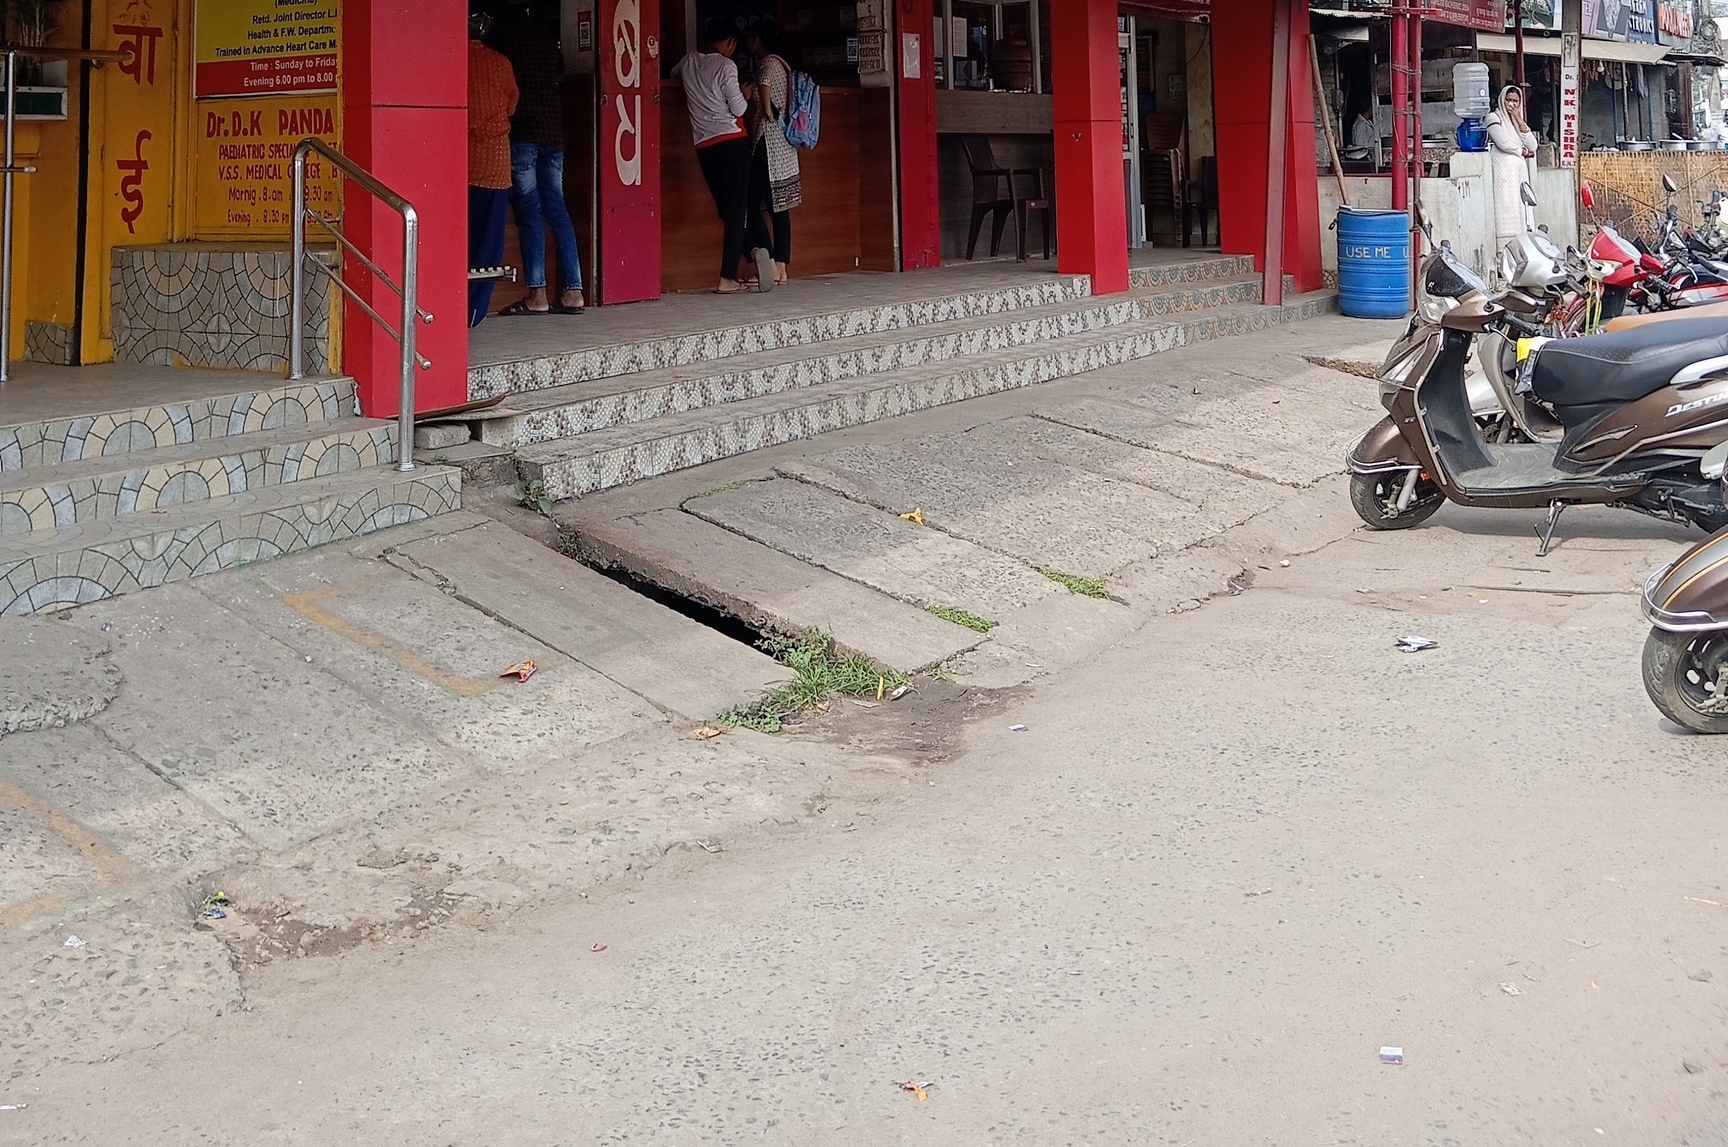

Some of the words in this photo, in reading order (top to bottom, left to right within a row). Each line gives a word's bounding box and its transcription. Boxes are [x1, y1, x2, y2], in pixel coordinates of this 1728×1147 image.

[252, 13, 272, 25] Retd.
[273, 12, 293, 23] Joint
[294, 9, 326, 21] Director
[247, 29, 271, 40] Health
[273, 28, 279, 37] &
[280, 26, 297, 37] F.W.
[215, 47, 242, 57] Trained
[252, 44, 285, 55] Advance
[286, 42, 307, 52] Heart
[308, 40, 327, 50] Care
[250, 61, 269, 71] Time
[275, 59, 304, 71] Sunday
[305, 59, 313, 68] to
[243, 77, 274, 87] Evening
[275, 75, 291, 85] 6.00
[293, 75, 305, 85] pm
[307, 74, 315, 83] to
[317, 73, 333, 83] 8.00
[278, 108, 334, 136] PANDA
[1563, 114, 1576, 158] MISHRA
[218, 143, 265, 160] PAEDIATRIC
[246, 164, 282, 180] MEDICAL
[228, 209, 250, 226] Evening
[1345, 246, 1371, 258] USE
[1375, 246, 1391, 258] ME
